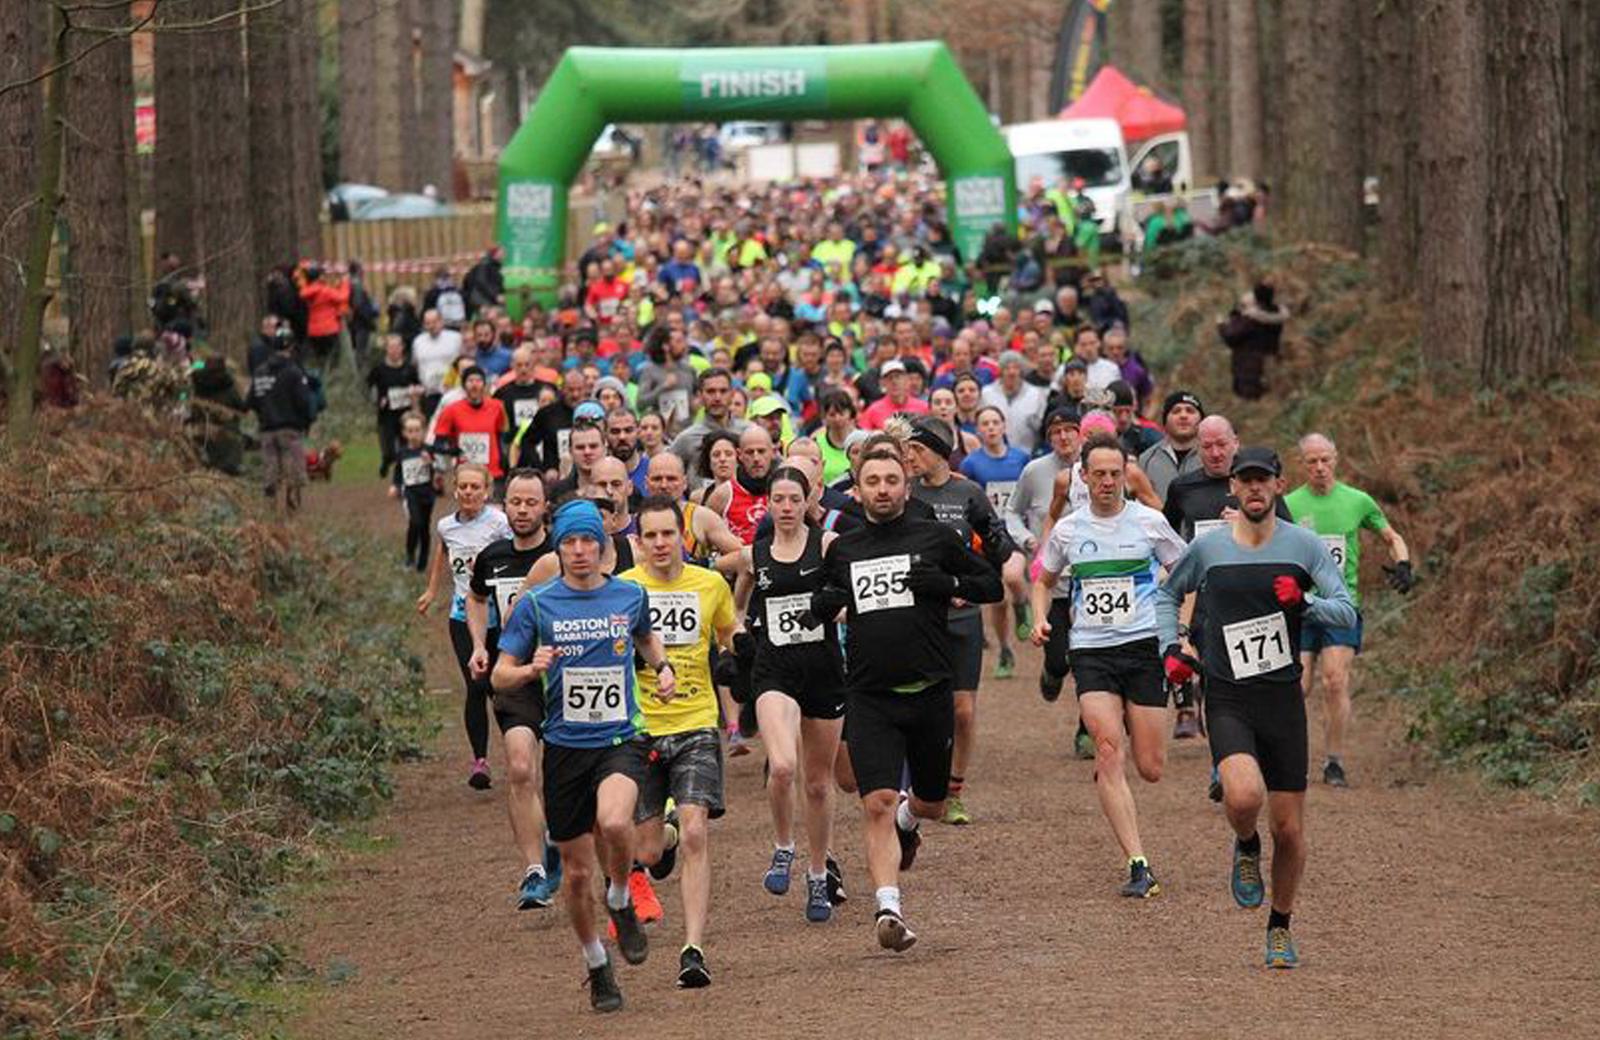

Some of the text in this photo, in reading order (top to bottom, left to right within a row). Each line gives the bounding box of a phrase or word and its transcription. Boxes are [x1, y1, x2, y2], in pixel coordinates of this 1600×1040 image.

[700, 70, 805, 98] FINISH
[857, 571, 907, 600] 255
[1086, 591, 1130, 615] 334
[553, 617, 608, 632] BOSTON
[649, 606, 697, 632] 246
[554, 630, 610, 642] MARATHON
[1234, 630, 1284, 664] 171
[568, 683, 621, 709] 576
